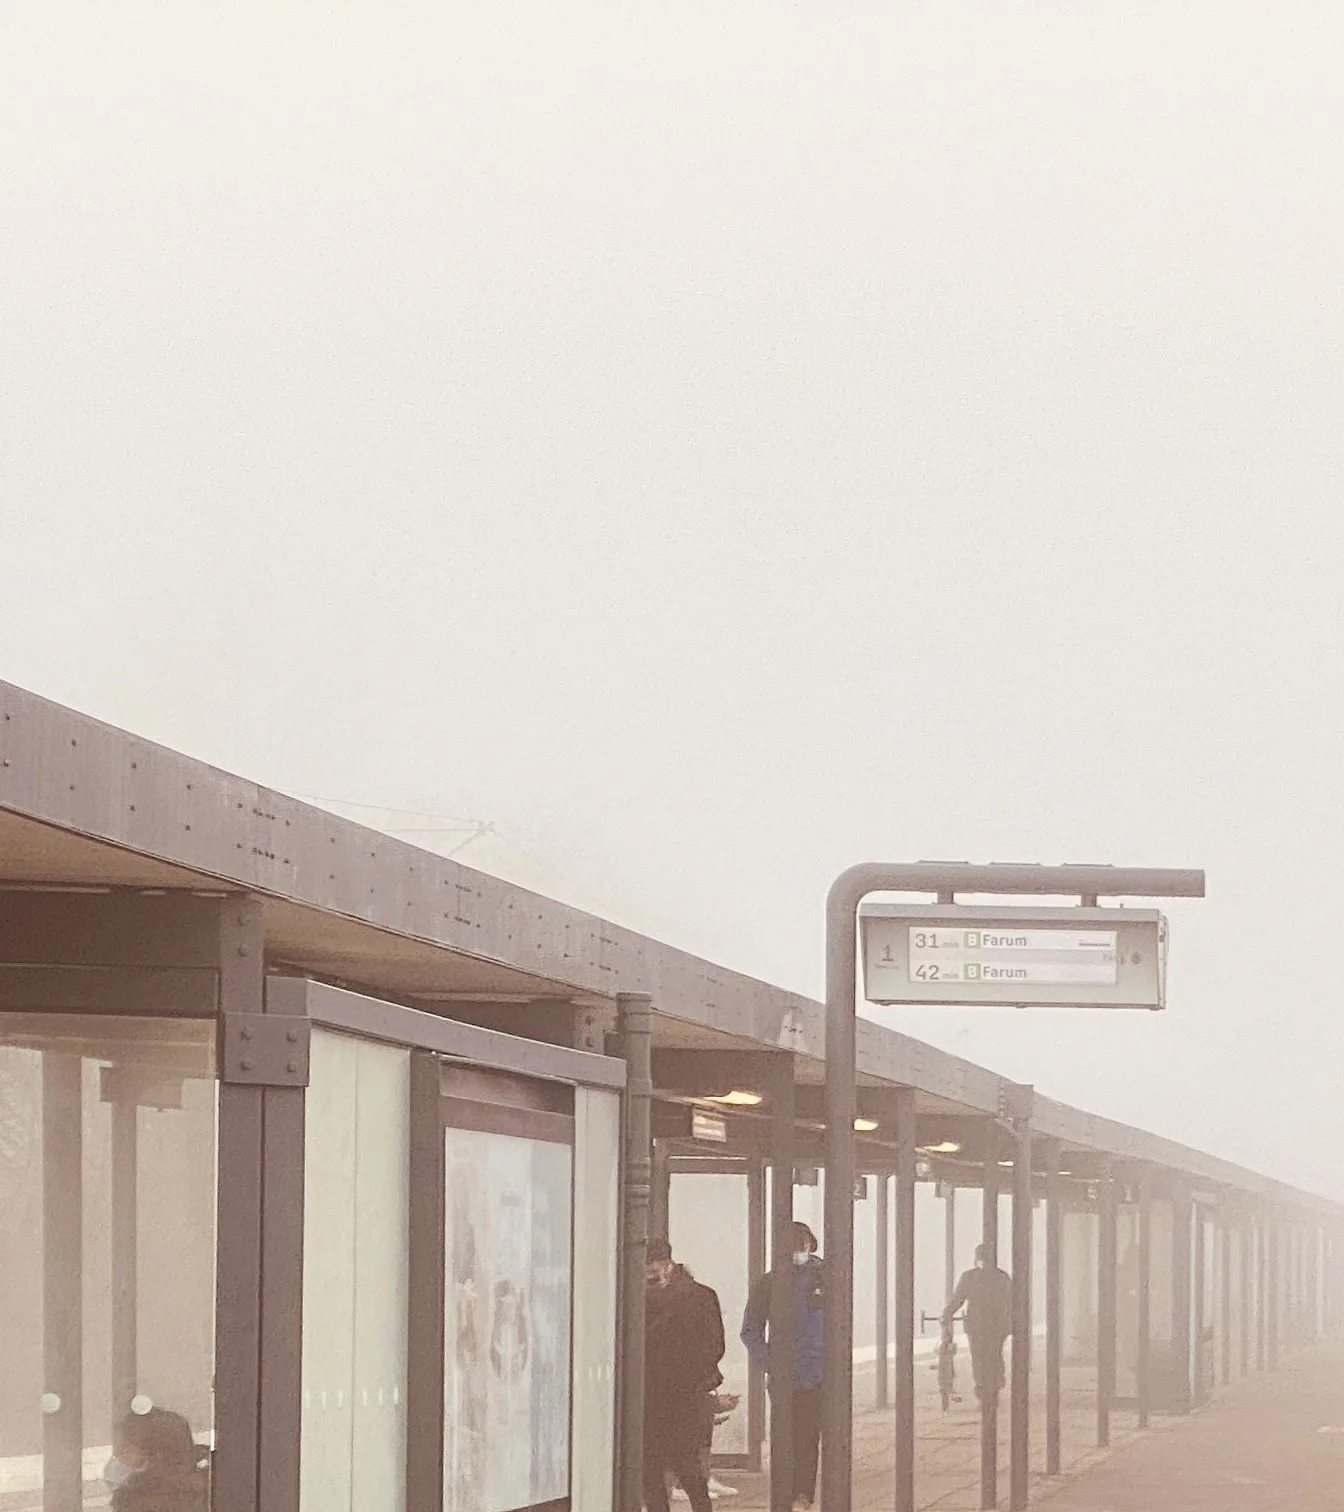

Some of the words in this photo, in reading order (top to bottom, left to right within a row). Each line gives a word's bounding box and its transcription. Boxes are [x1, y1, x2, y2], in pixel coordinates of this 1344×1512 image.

[915, 933, 940, 949] 31
[982, 934, 1028, 947] Farum
[915, 965, 941, 980] 42
[982, 966, 1028, 979] Farum
